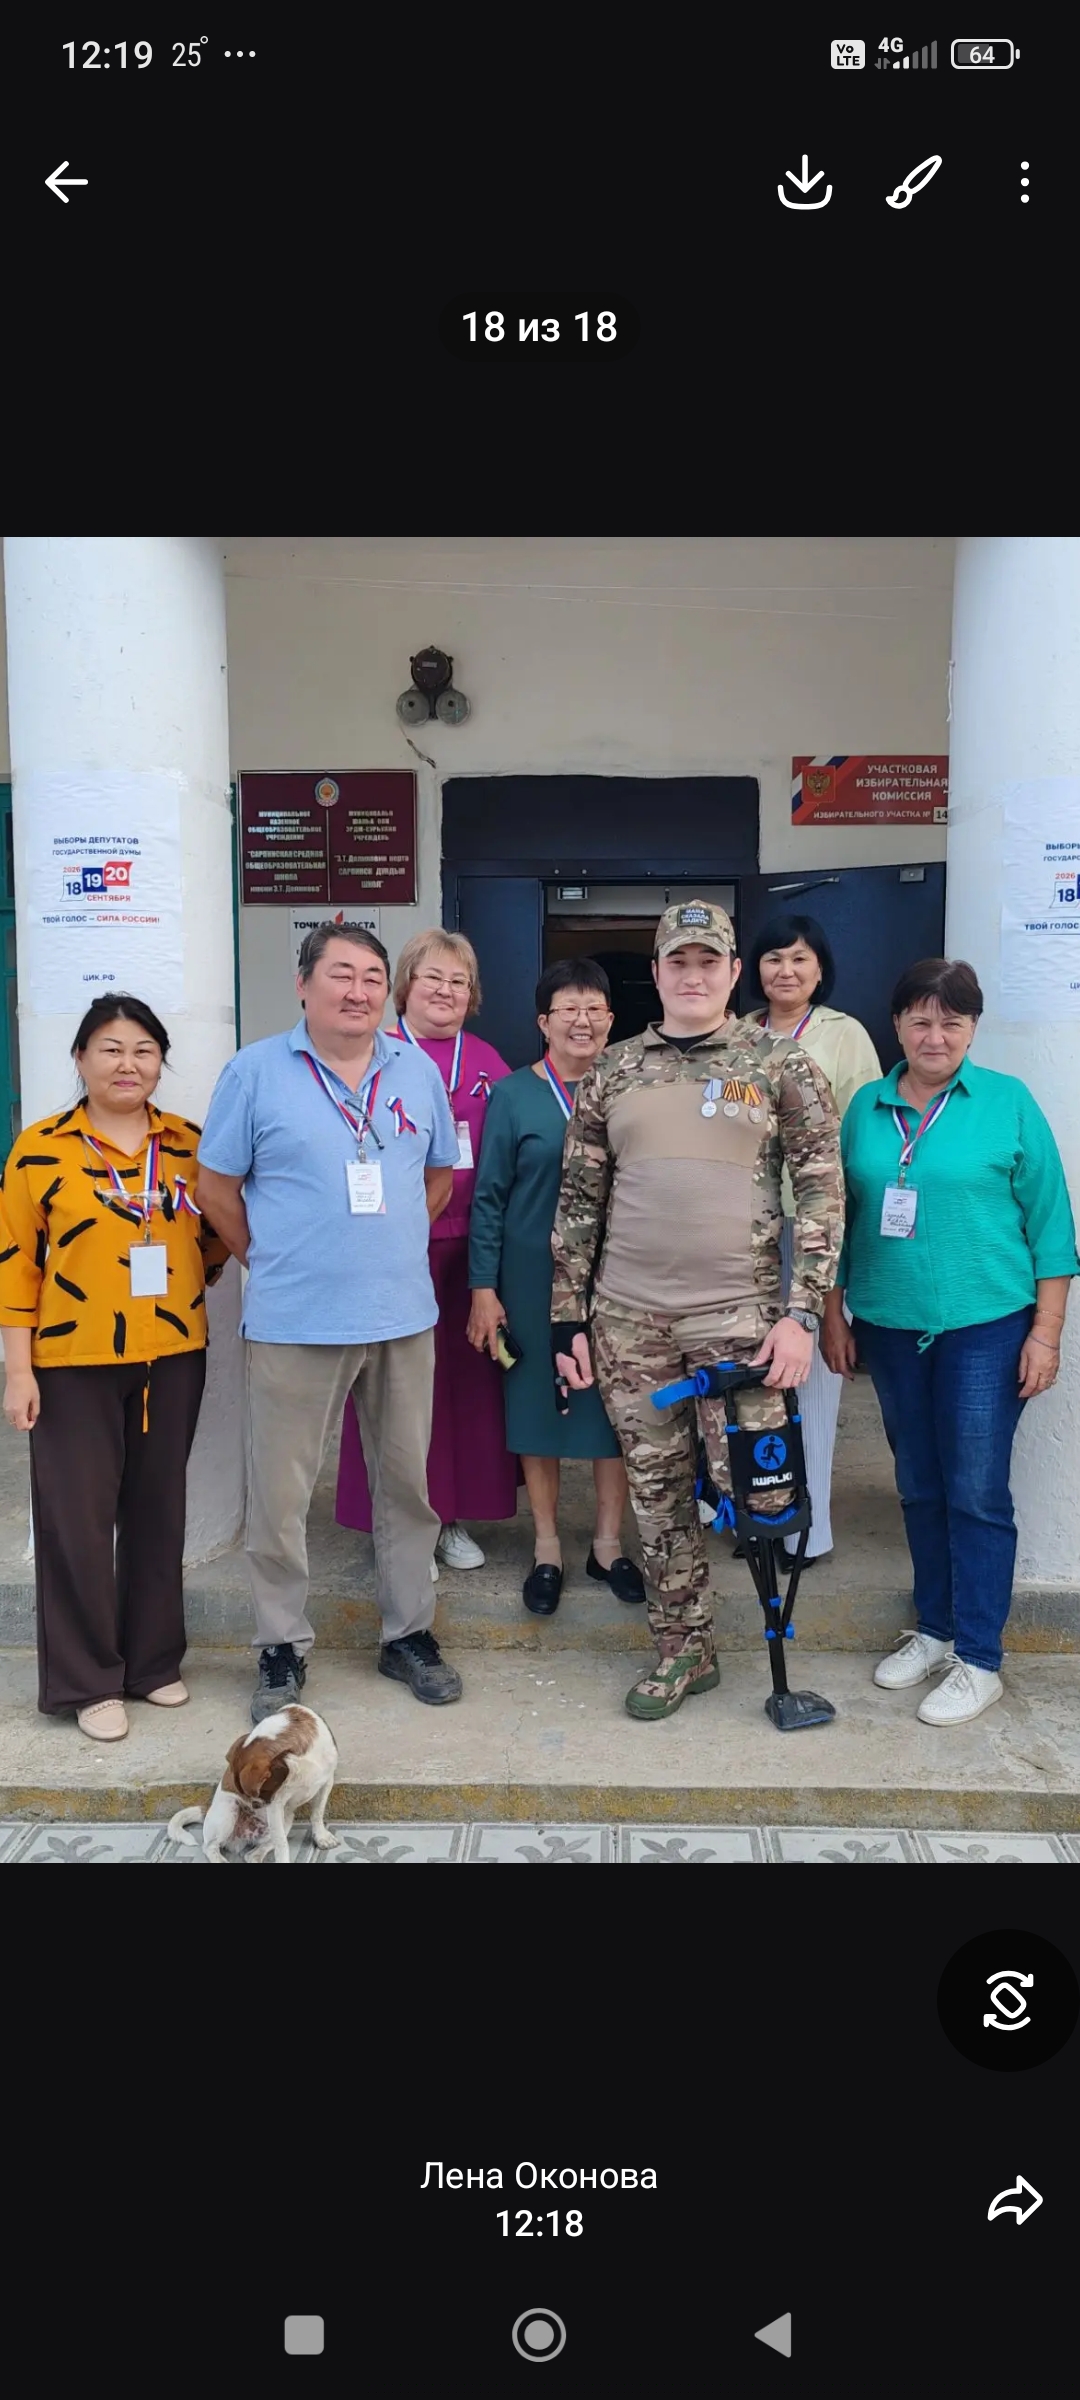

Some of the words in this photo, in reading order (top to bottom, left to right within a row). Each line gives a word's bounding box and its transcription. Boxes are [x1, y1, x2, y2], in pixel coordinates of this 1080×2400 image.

[867, 764, 938, 774] УЧАСТКОВАЯ
[856, 778, 948, 788] ИЗБИРАТЕЛЬНАЯ
[872, 791, 932, 801] КОМИССИЯ
[813, 810, 884, 819] ИЗБИРАТЕЛЬНОГО
[886, 810, 921, 818] УЧАСТКА
[53, 837, 87, 845] ВЫБОРЫ
[88, 836, 139, 845] ДЕПУТАТОВ
[52, 848, 118, 856] ГОСУДАРСТВЕННОЙ
[65, 882, 82, 895] 18
[84, 873, 102, 888] 19
[105, 866, 128, 881] 20
[87, 894, 131, 902] СЕНТЯБРЯ
[1057, 888, 1075, 903] 18
[42, 915, 60, 924] ТВОЙ
[1025, 922, 1048, 931] ТВОЙ
[1050, 922, 1079, 930] ГОЛОС
[83, 973, 116, 982] ЦИК.РФ
